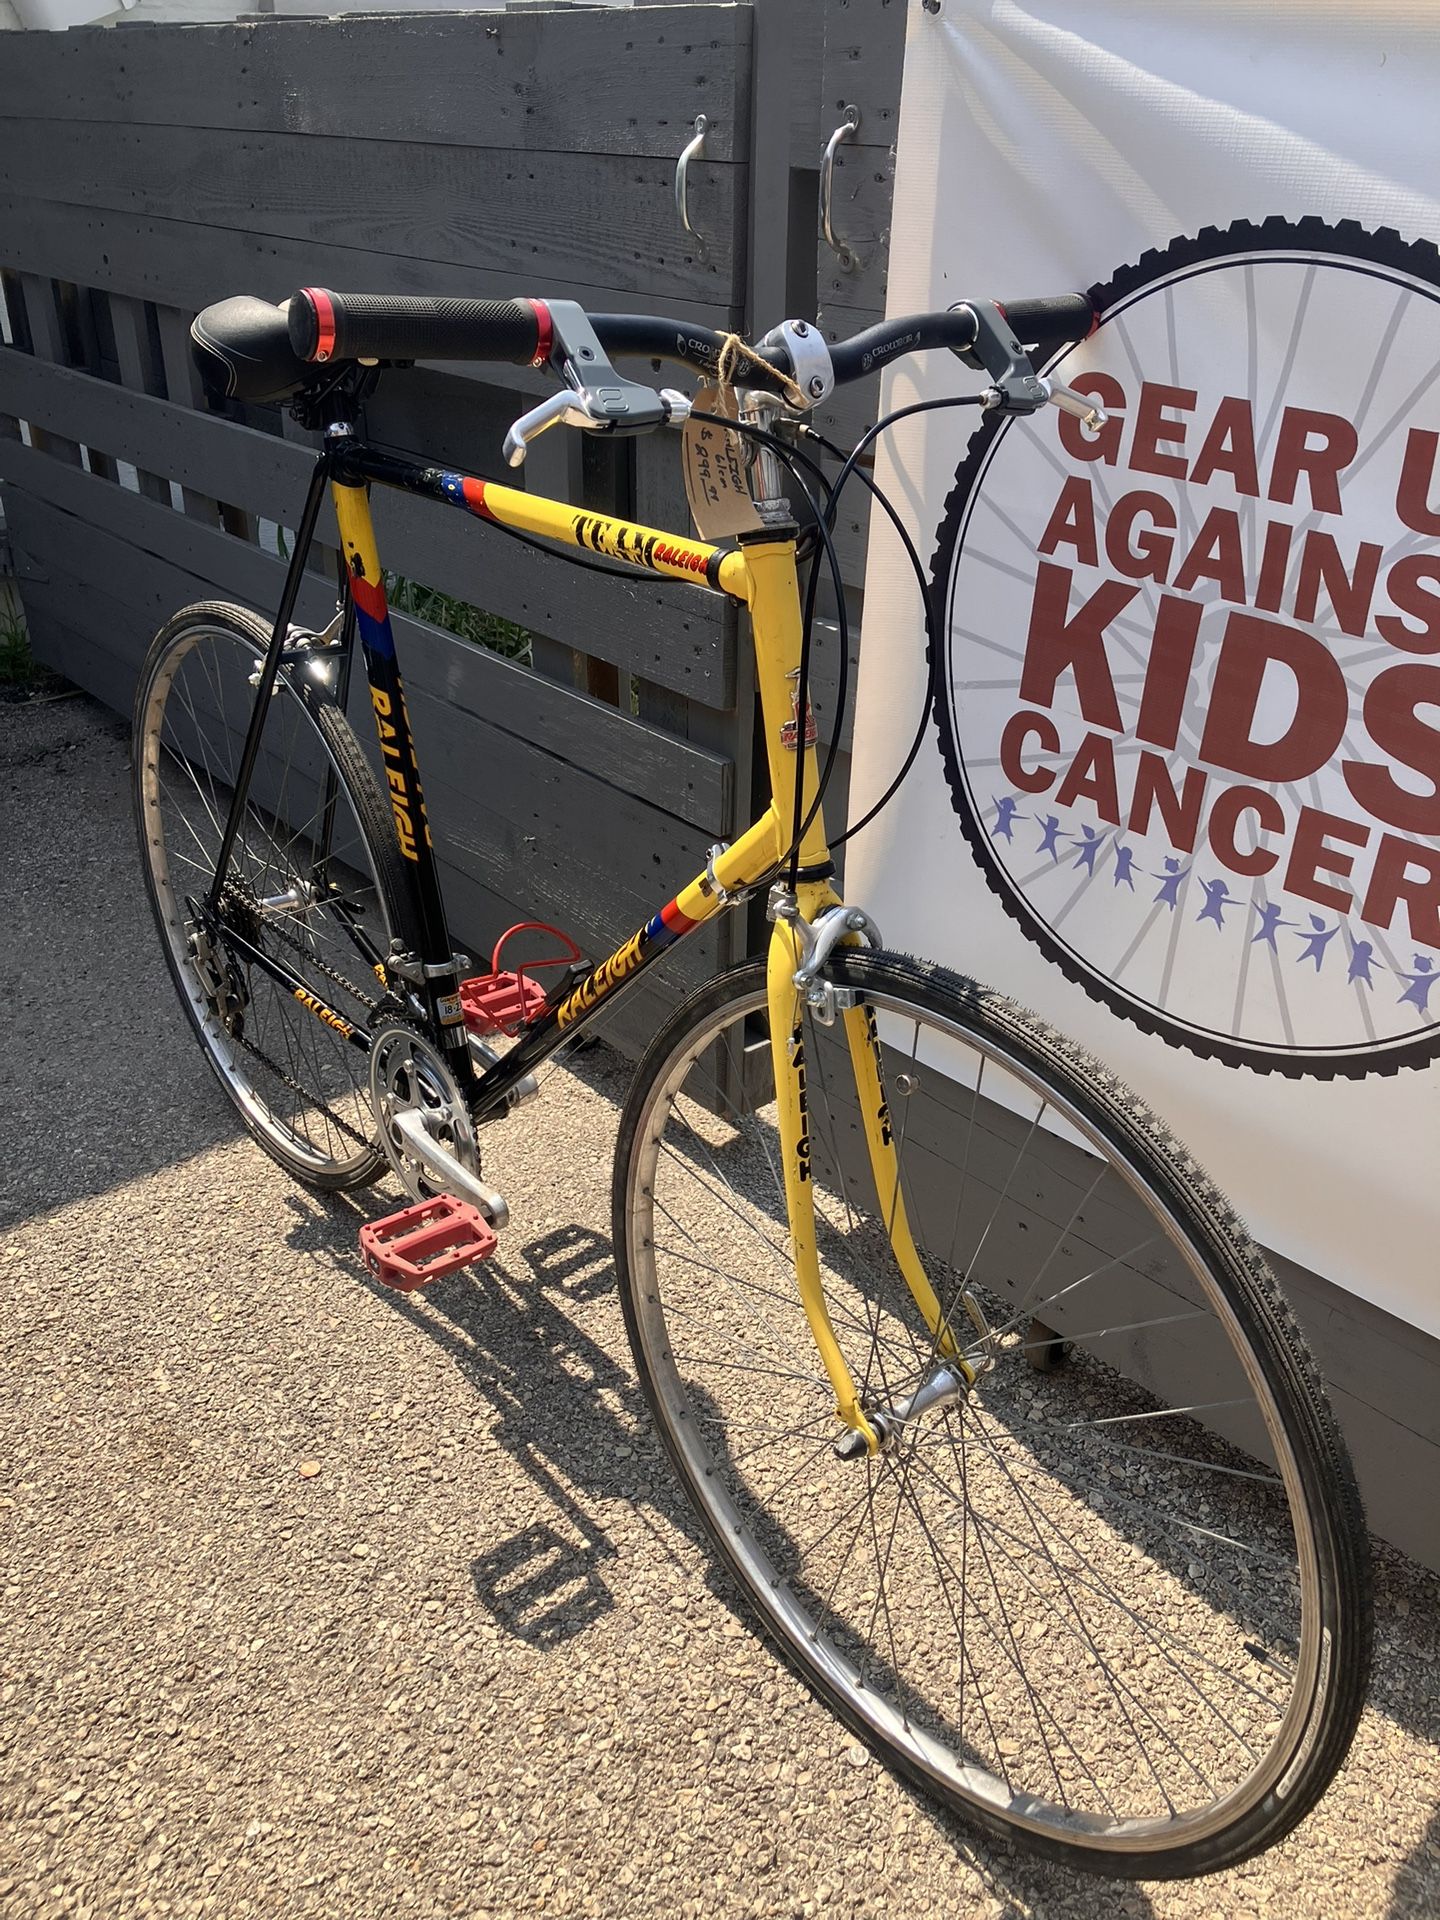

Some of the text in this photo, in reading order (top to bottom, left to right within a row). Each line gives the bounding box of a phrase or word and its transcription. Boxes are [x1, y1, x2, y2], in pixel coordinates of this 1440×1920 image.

[1059, 371, 1358, 516] GEAR
[1019, 562, 1440, 837] KIDS
[1000, 710, 1440, 950] CANCER
[294, 988, 356, 1041] RALEIGH
[557, 927, 645, 1030] RALEIGH
